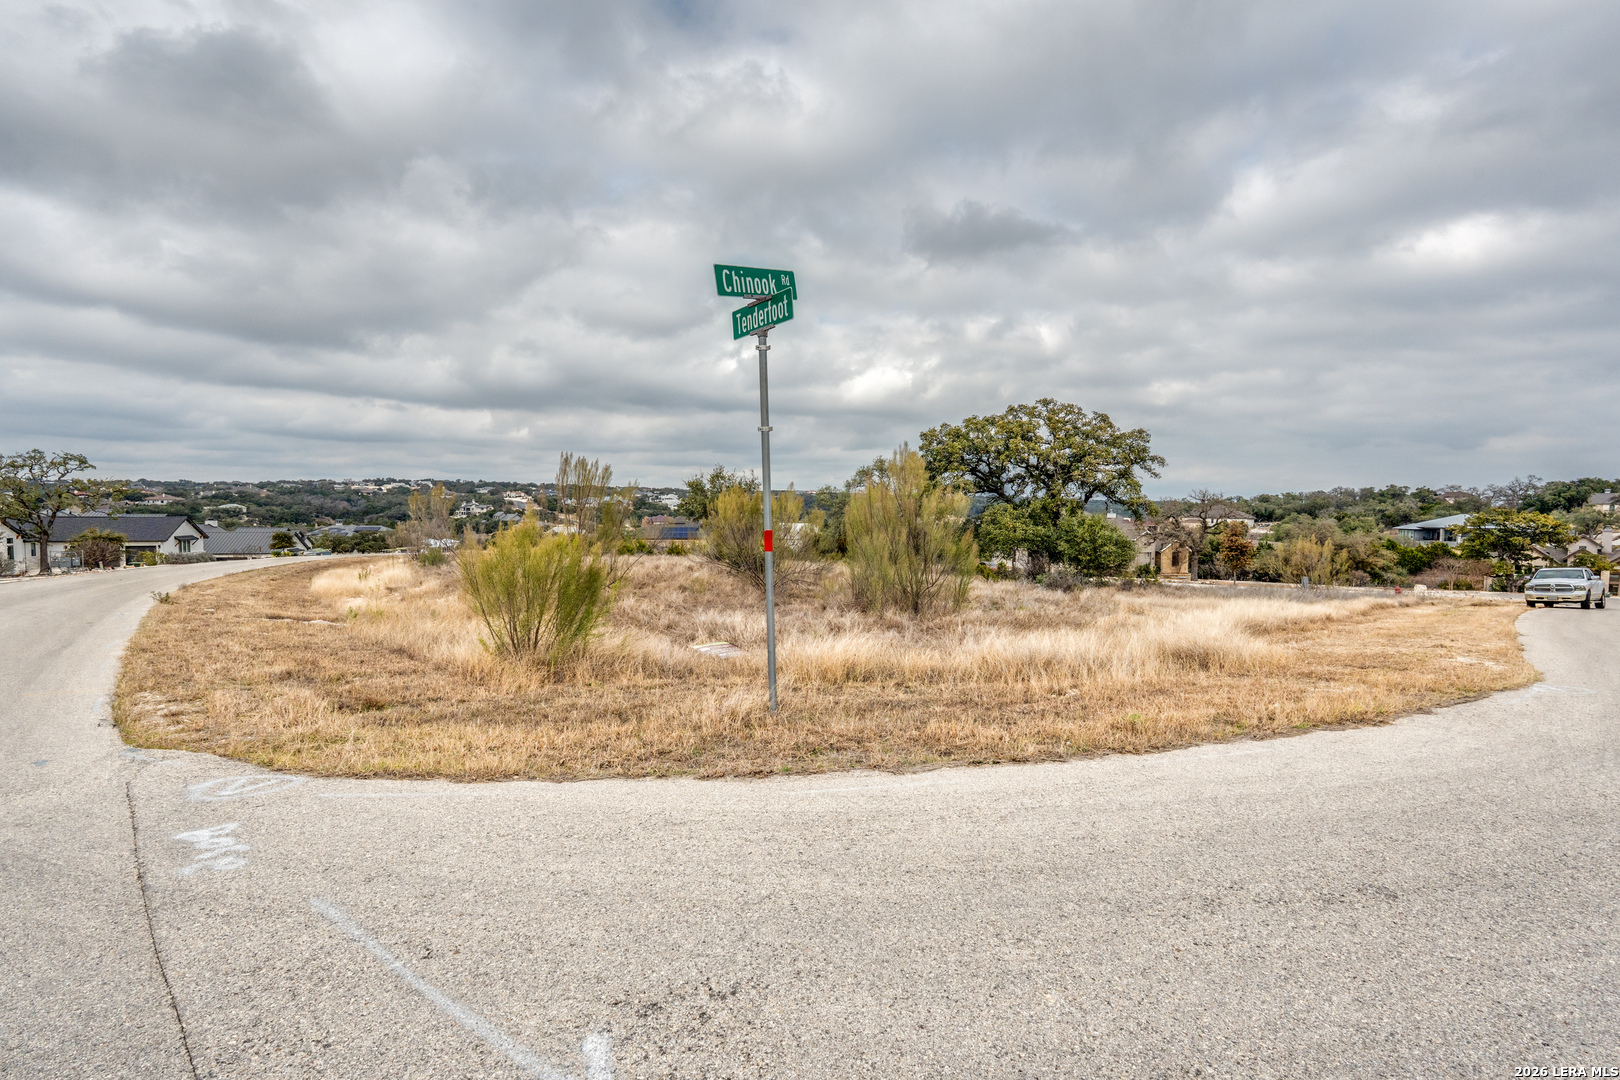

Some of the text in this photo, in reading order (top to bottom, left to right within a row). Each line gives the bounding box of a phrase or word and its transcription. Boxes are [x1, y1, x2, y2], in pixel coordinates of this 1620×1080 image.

[722, 269, 790, 295] Chinook Rd
[736, 294, 789, 335] Tenderfoot
